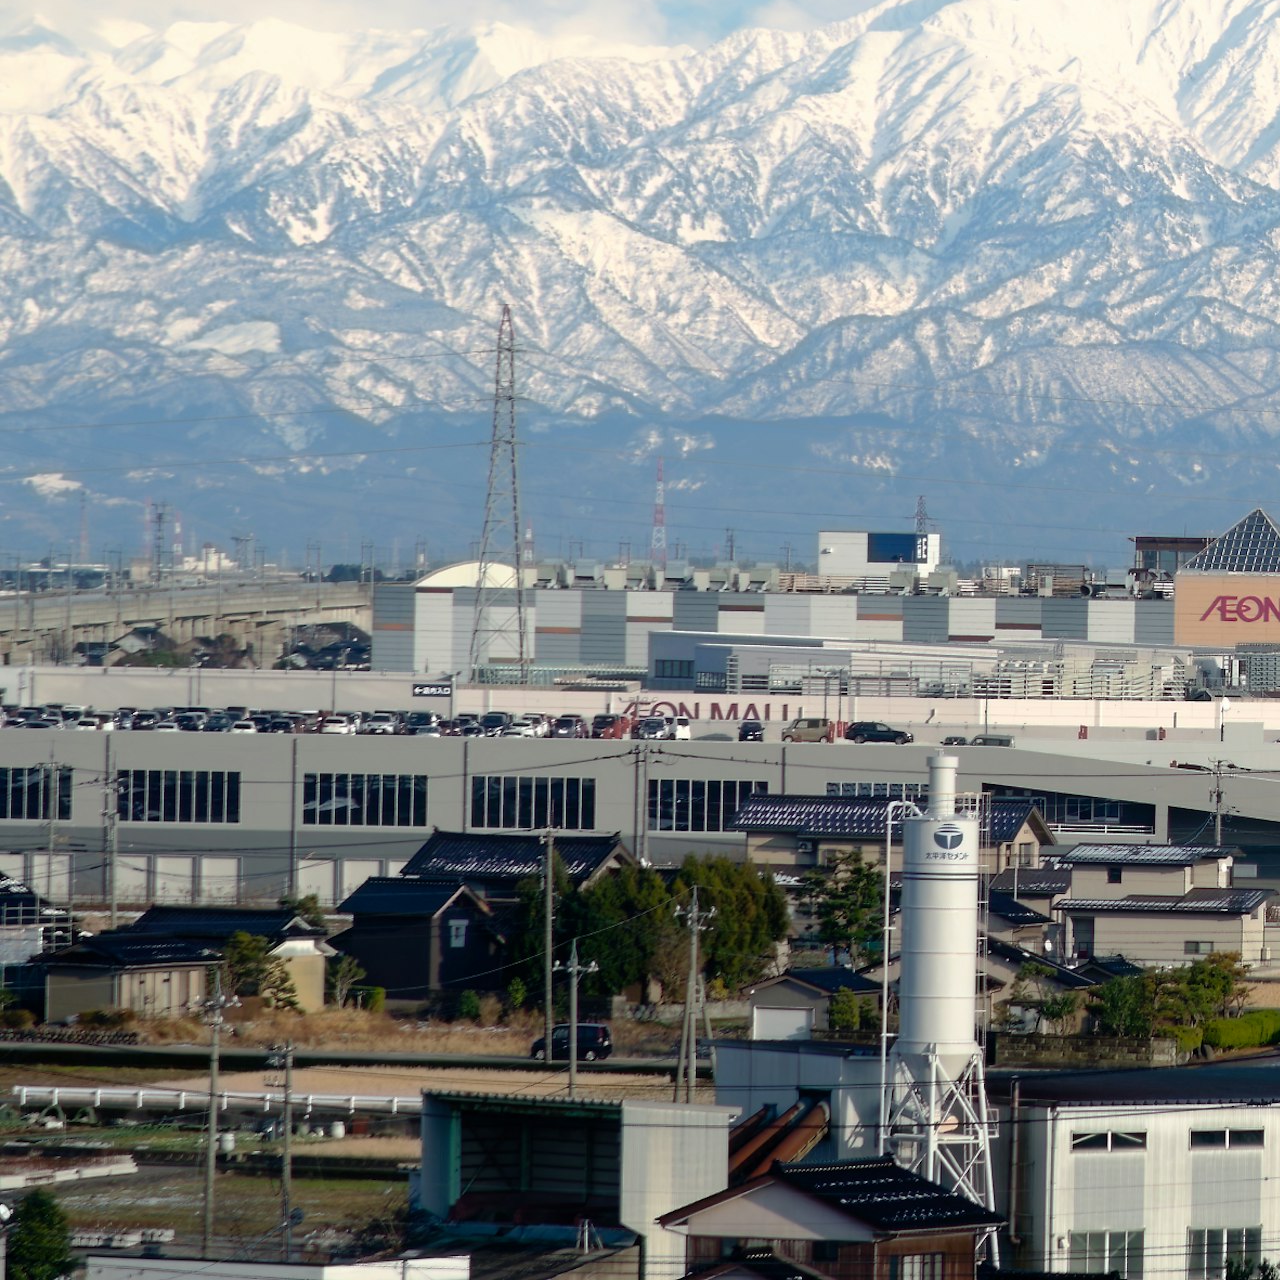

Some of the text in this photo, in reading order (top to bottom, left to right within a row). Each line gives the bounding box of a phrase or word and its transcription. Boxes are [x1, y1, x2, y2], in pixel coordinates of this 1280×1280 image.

[925, 852, 969, 860] 太平洋セメント
